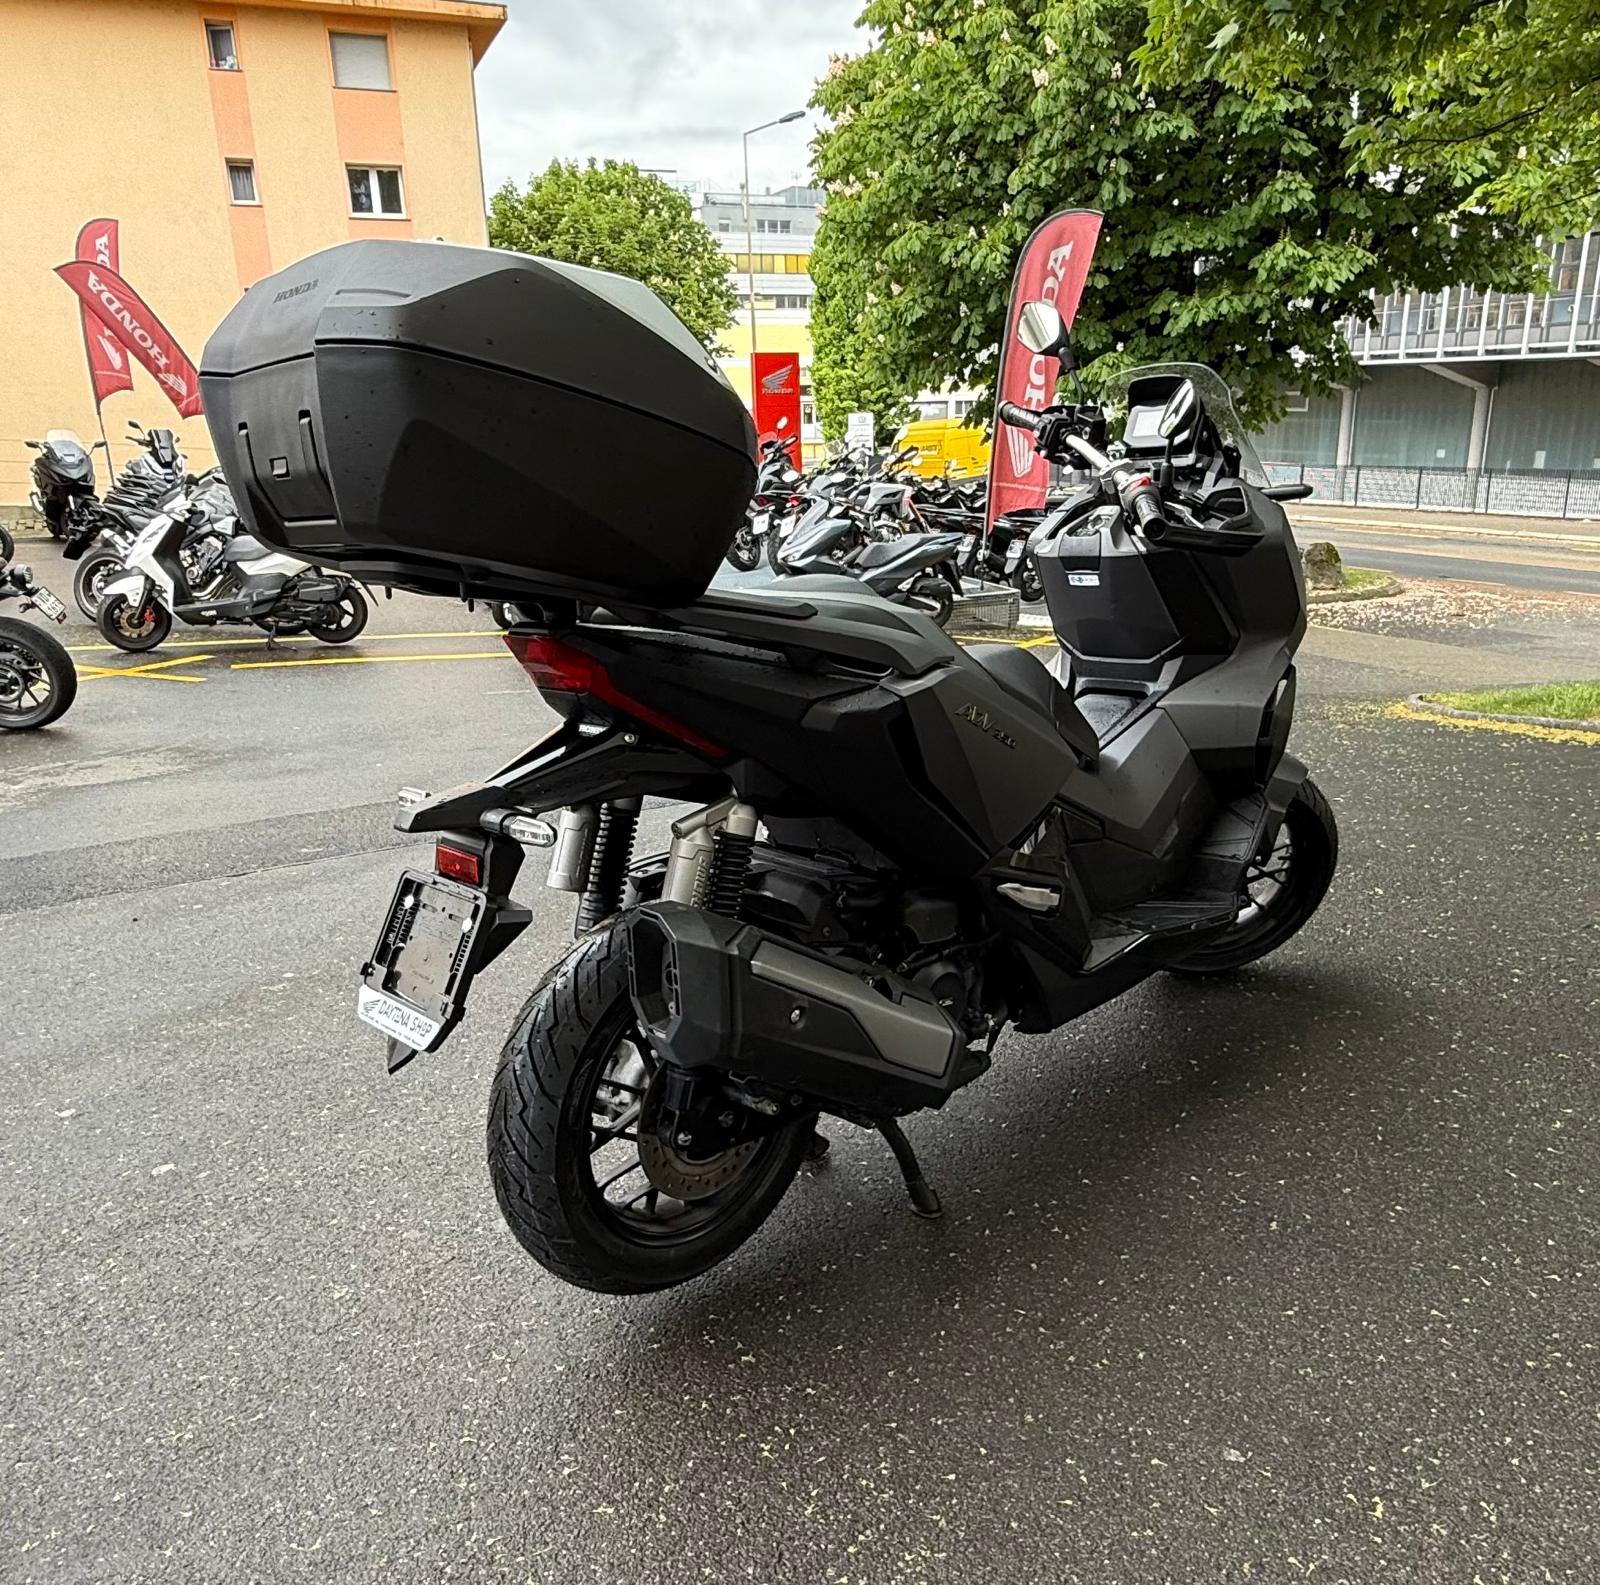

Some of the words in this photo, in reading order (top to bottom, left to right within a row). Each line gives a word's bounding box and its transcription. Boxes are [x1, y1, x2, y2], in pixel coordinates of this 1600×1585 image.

[87, 270, 170, 369] HONDA
[272, 278, 319, 305] HONDA
[1024, 240, 1074, 411] HODA
